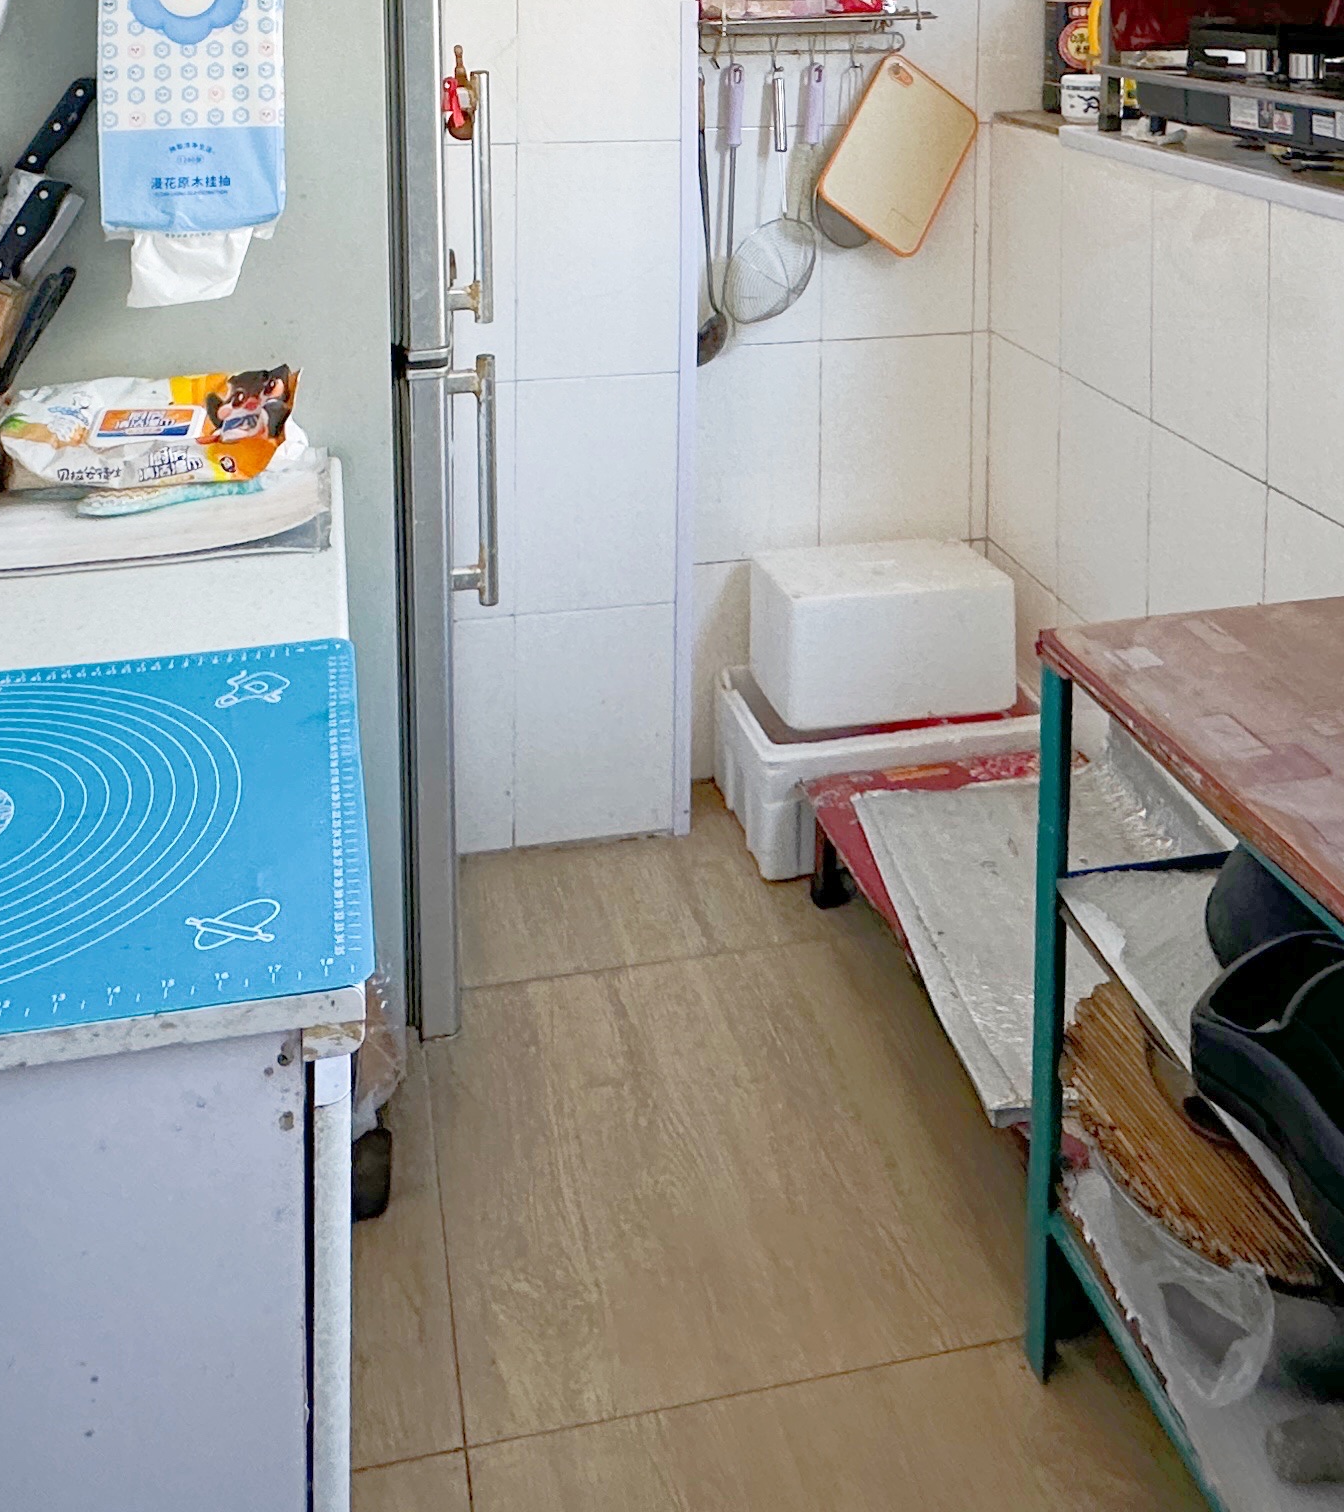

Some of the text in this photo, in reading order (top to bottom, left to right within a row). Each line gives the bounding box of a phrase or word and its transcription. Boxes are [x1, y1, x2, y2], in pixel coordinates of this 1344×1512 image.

[150, 174, 232, 190] 漫花原木挂抽
